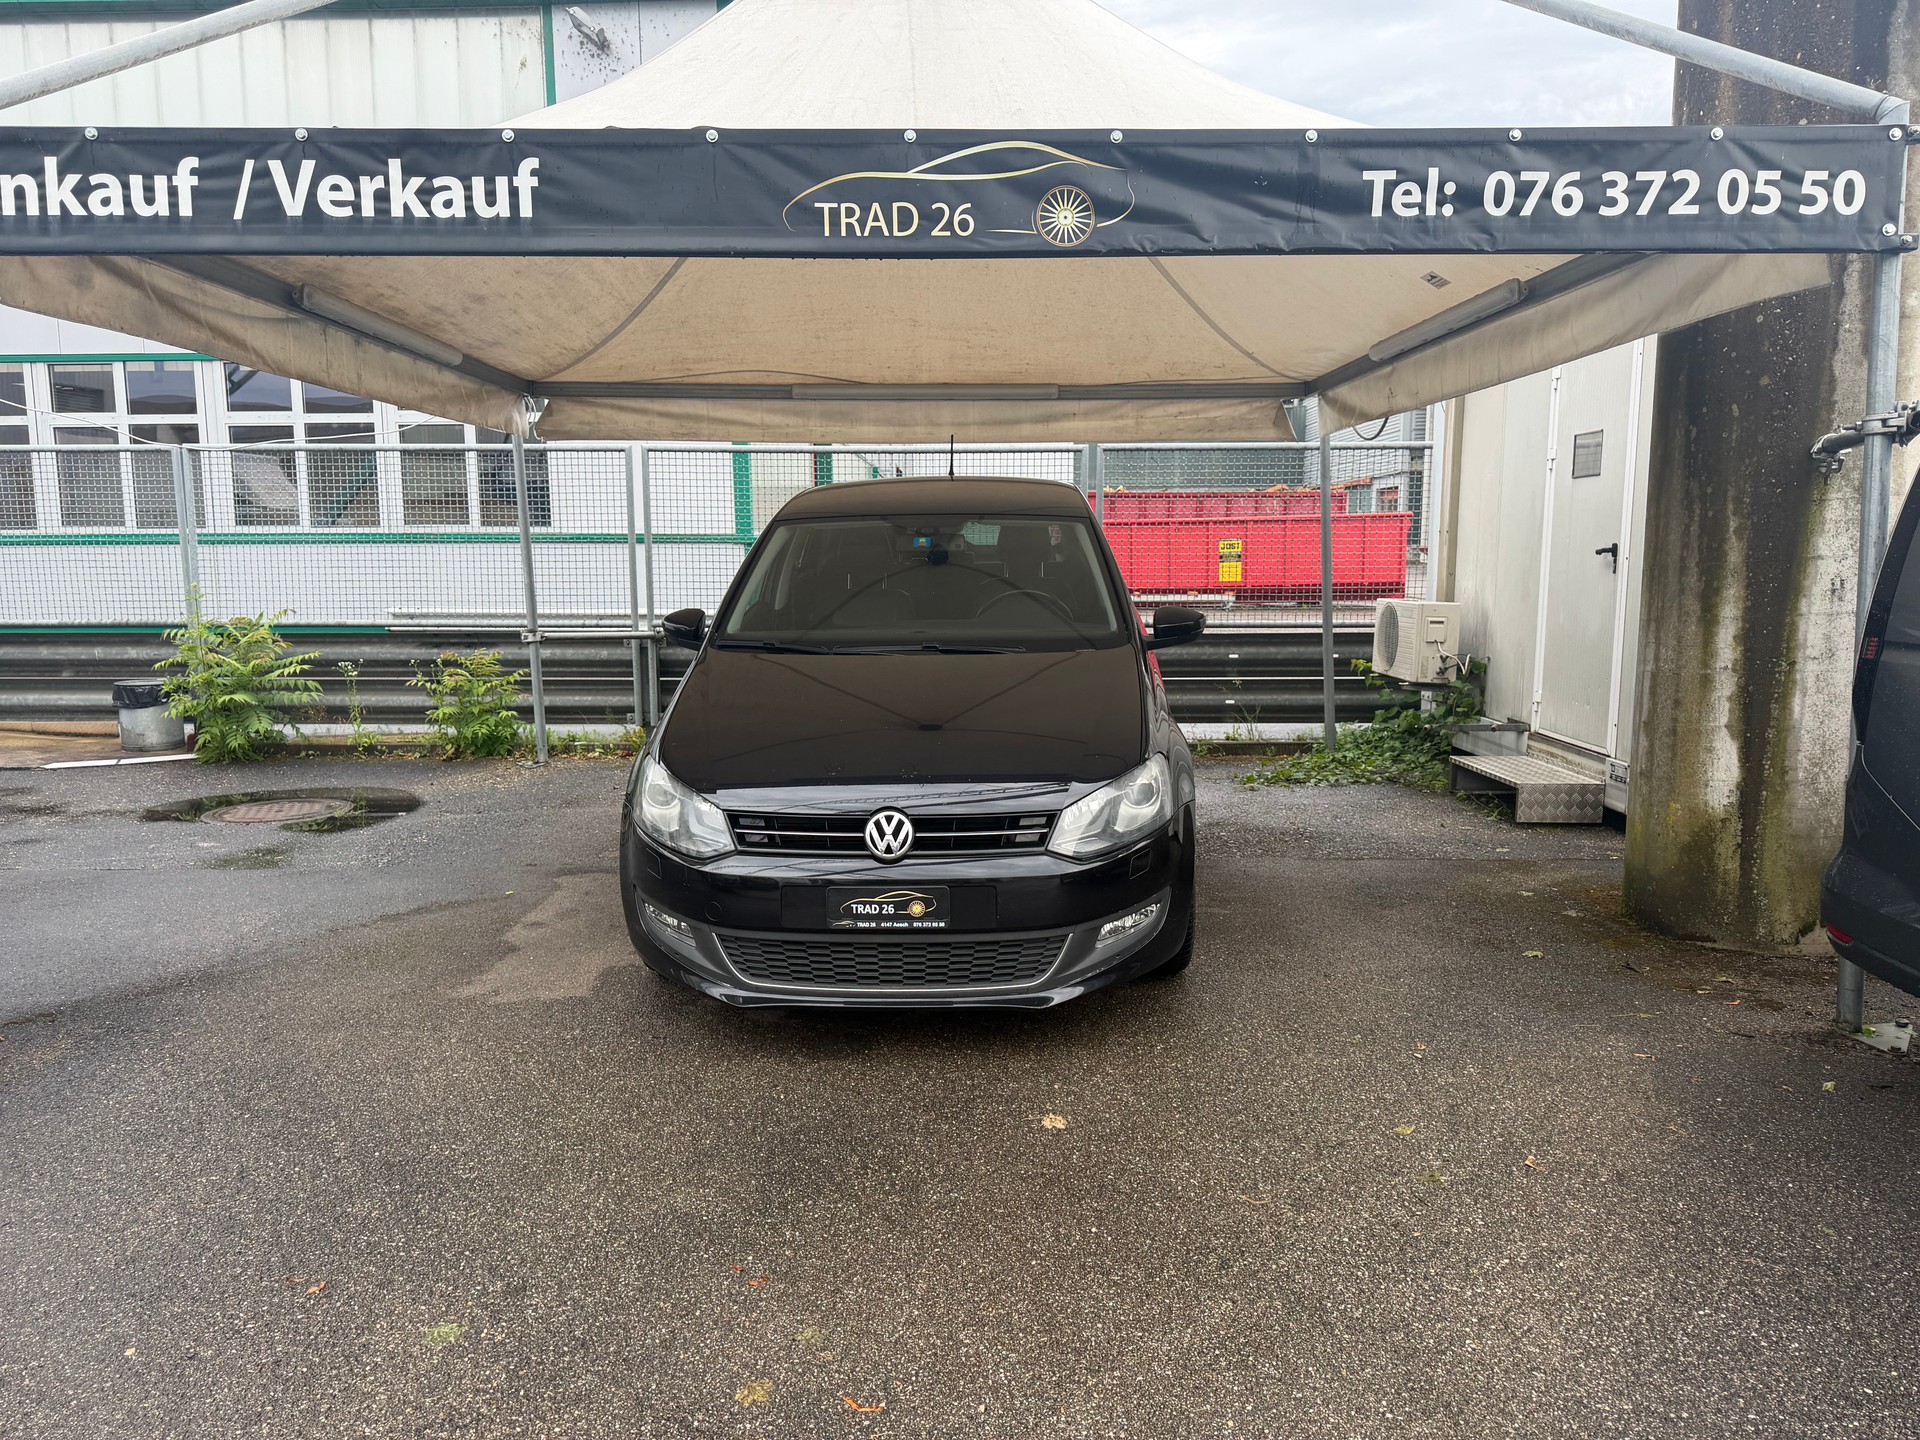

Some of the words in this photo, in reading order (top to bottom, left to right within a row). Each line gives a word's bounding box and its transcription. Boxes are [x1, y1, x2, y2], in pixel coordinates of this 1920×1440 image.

[0, 156, 199, 217] nkauf
[1362, 167, 1457, 218] Tel:
[1483, 170, 1584, 217] 076
[1598, 169, 1701, 217] 372
[1717, 169, 1782, 216] 05
[1798, 169, 1867, 216] 50
[814, 201, 919, 237] TRAD
[931, 202, 975, 237] 26
[850, 903, 880, 915] TRAD
[881, 903, 895, 915] 26
